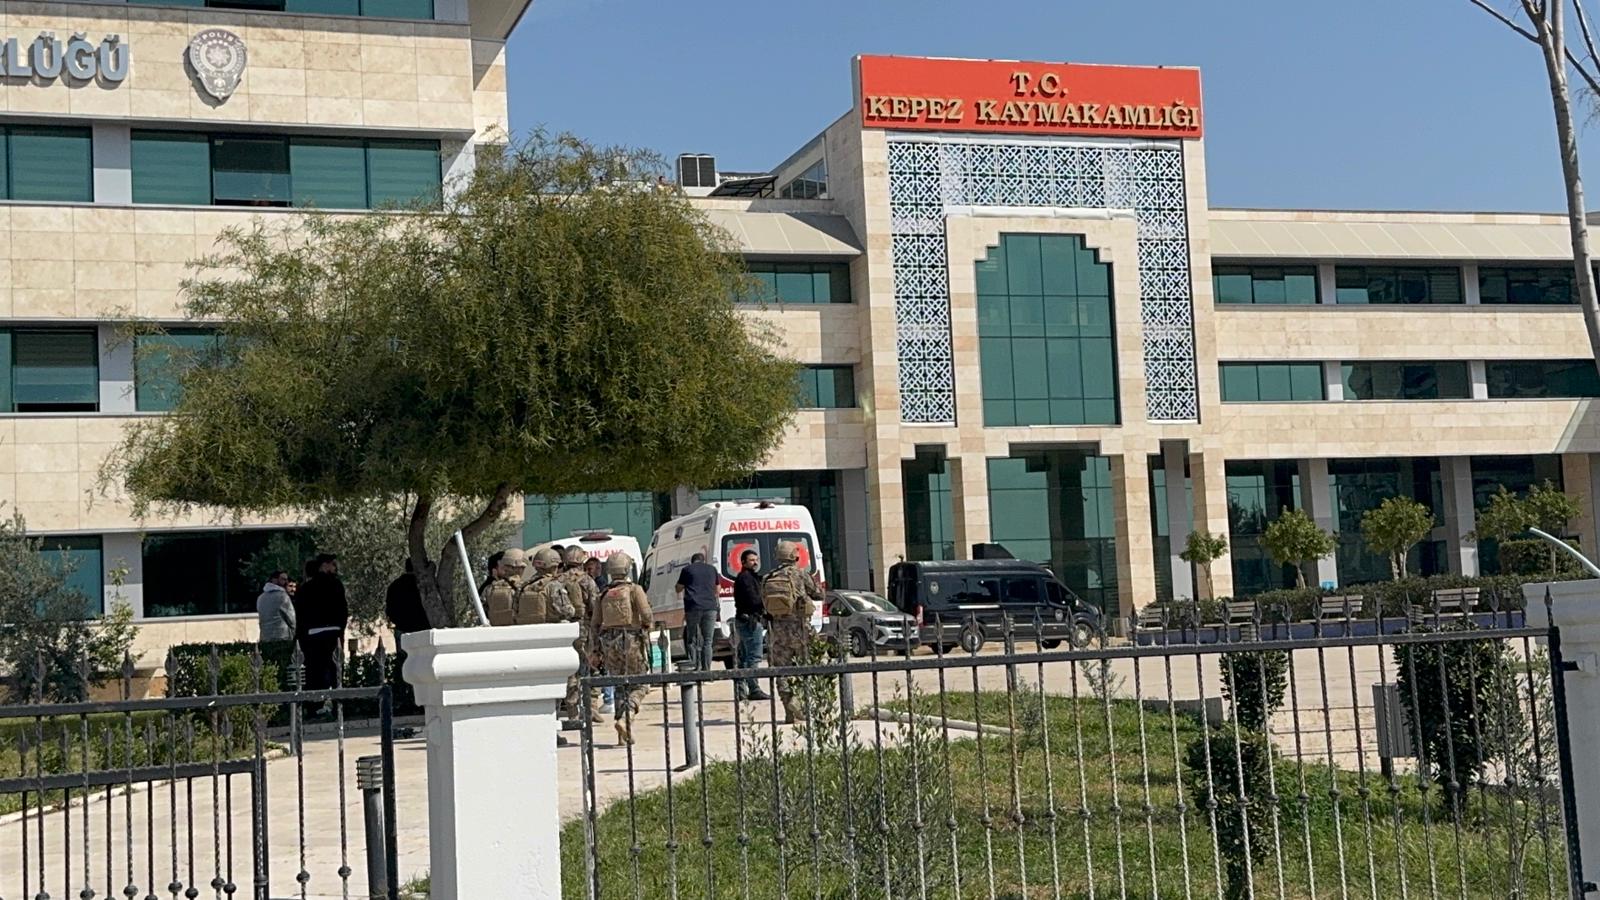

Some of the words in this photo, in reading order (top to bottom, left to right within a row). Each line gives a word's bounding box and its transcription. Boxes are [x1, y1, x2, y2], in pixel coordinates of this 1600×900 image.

[0, 31, 129, 81] LÜĞÜ
[1012, 71, 1069, 95] T.C.
[867, 95, 964, 121] KEPEZ
[976, 98, 1200, 129] KAYMAKAMLIĞI
[729, 520, 800, 532] AMBULANS
